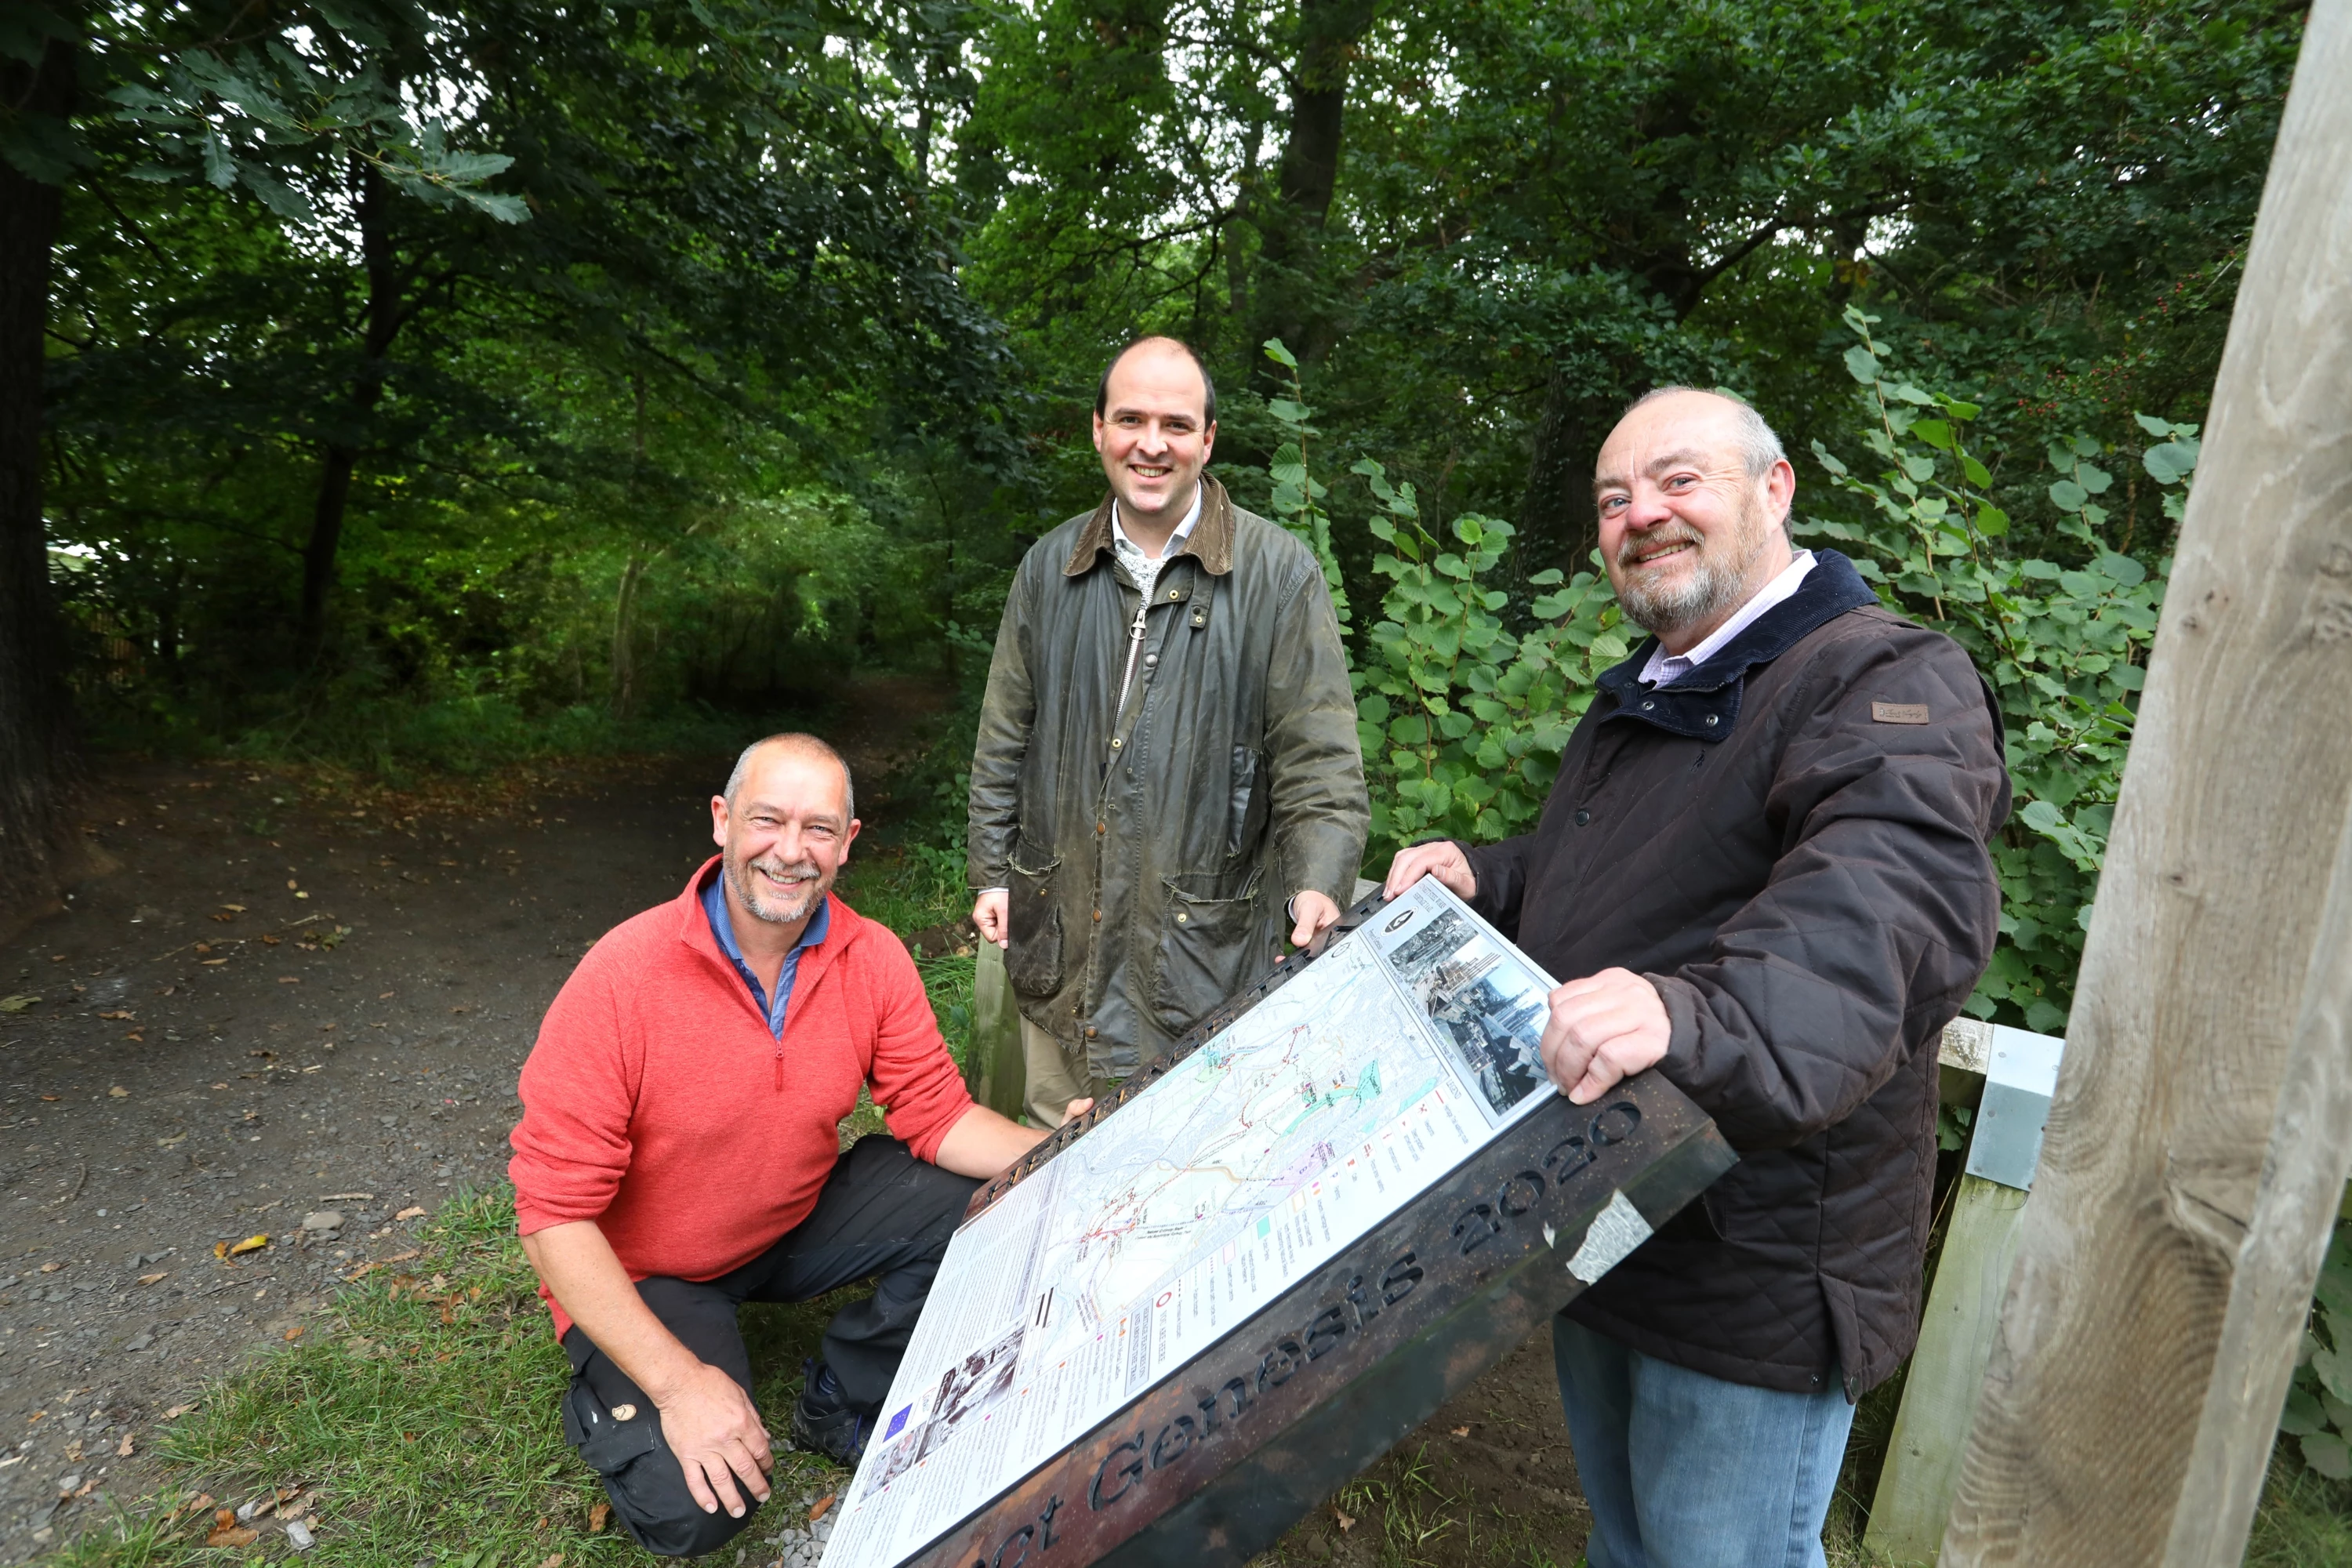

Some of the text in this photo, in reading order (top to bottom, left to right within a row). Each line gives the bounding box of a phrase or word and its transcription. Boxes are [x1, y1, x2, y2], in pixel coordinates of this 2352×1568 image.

[1087, 1251, 1425, 1512] Genesis
[1449, 1102, 1642, 1256] 2020
[1139, 1366, 1144, 1377] ON
